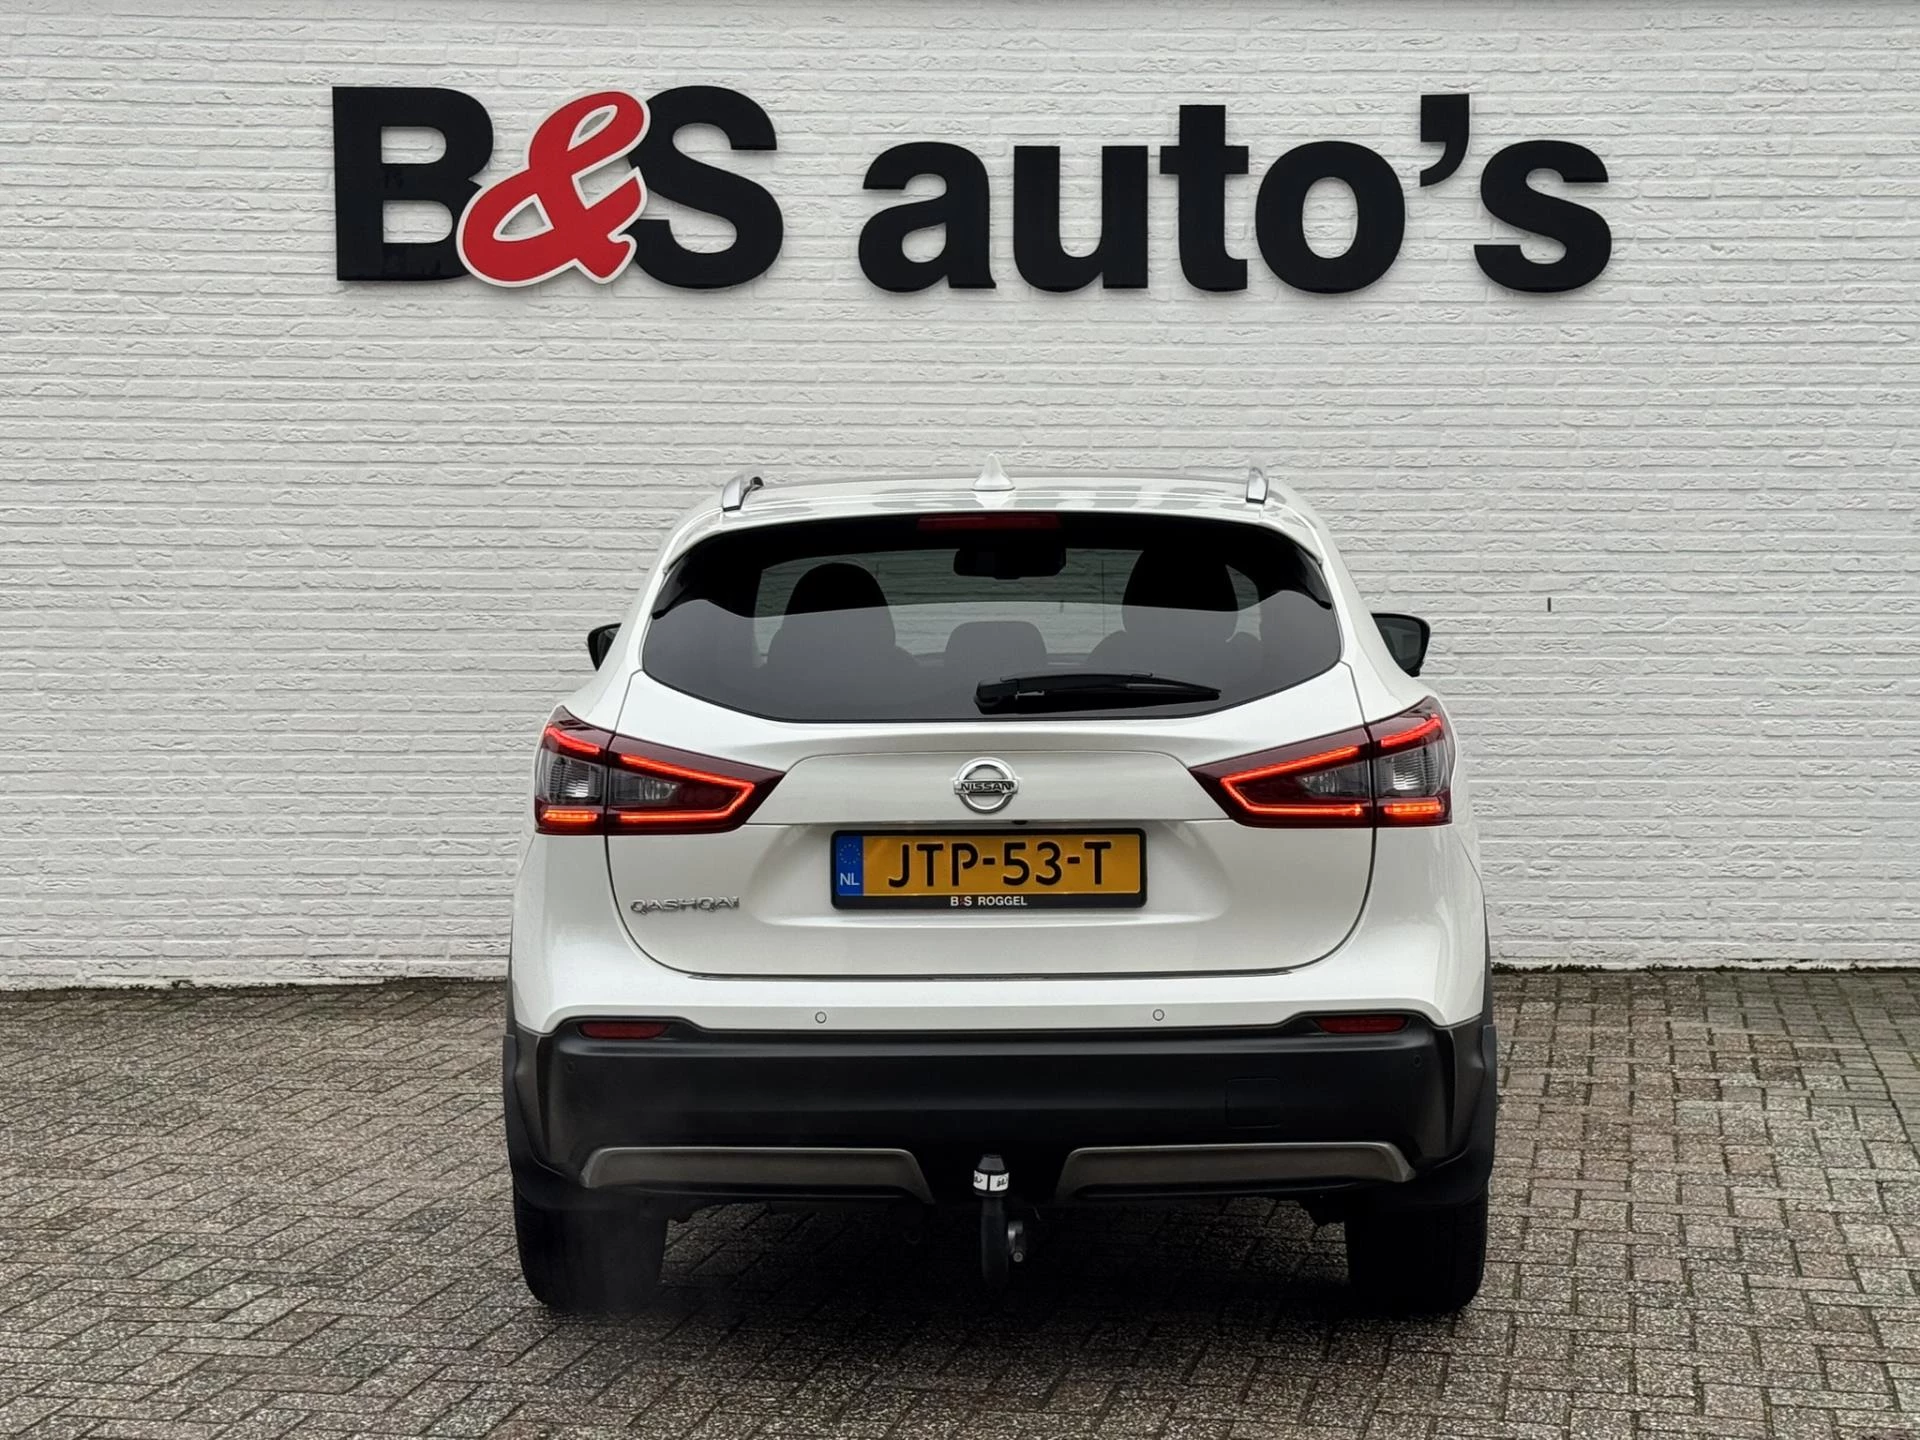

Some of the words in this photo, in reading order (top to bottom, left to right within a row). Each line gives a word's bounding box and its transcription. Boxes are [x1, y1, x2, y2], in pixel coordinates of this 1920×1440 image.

[332, 85, 784, 289] B&S
[858, 93, 1612, 292] auto's
[961, 782, 1014, 792] NISSAN
[887, 840, 1112, 888] JTP-53-T
[840, 872, 860, 886] NL
[630, 896, 740, 914] QASHQAI
[977, 895, 1028, 906] ROGGEL
